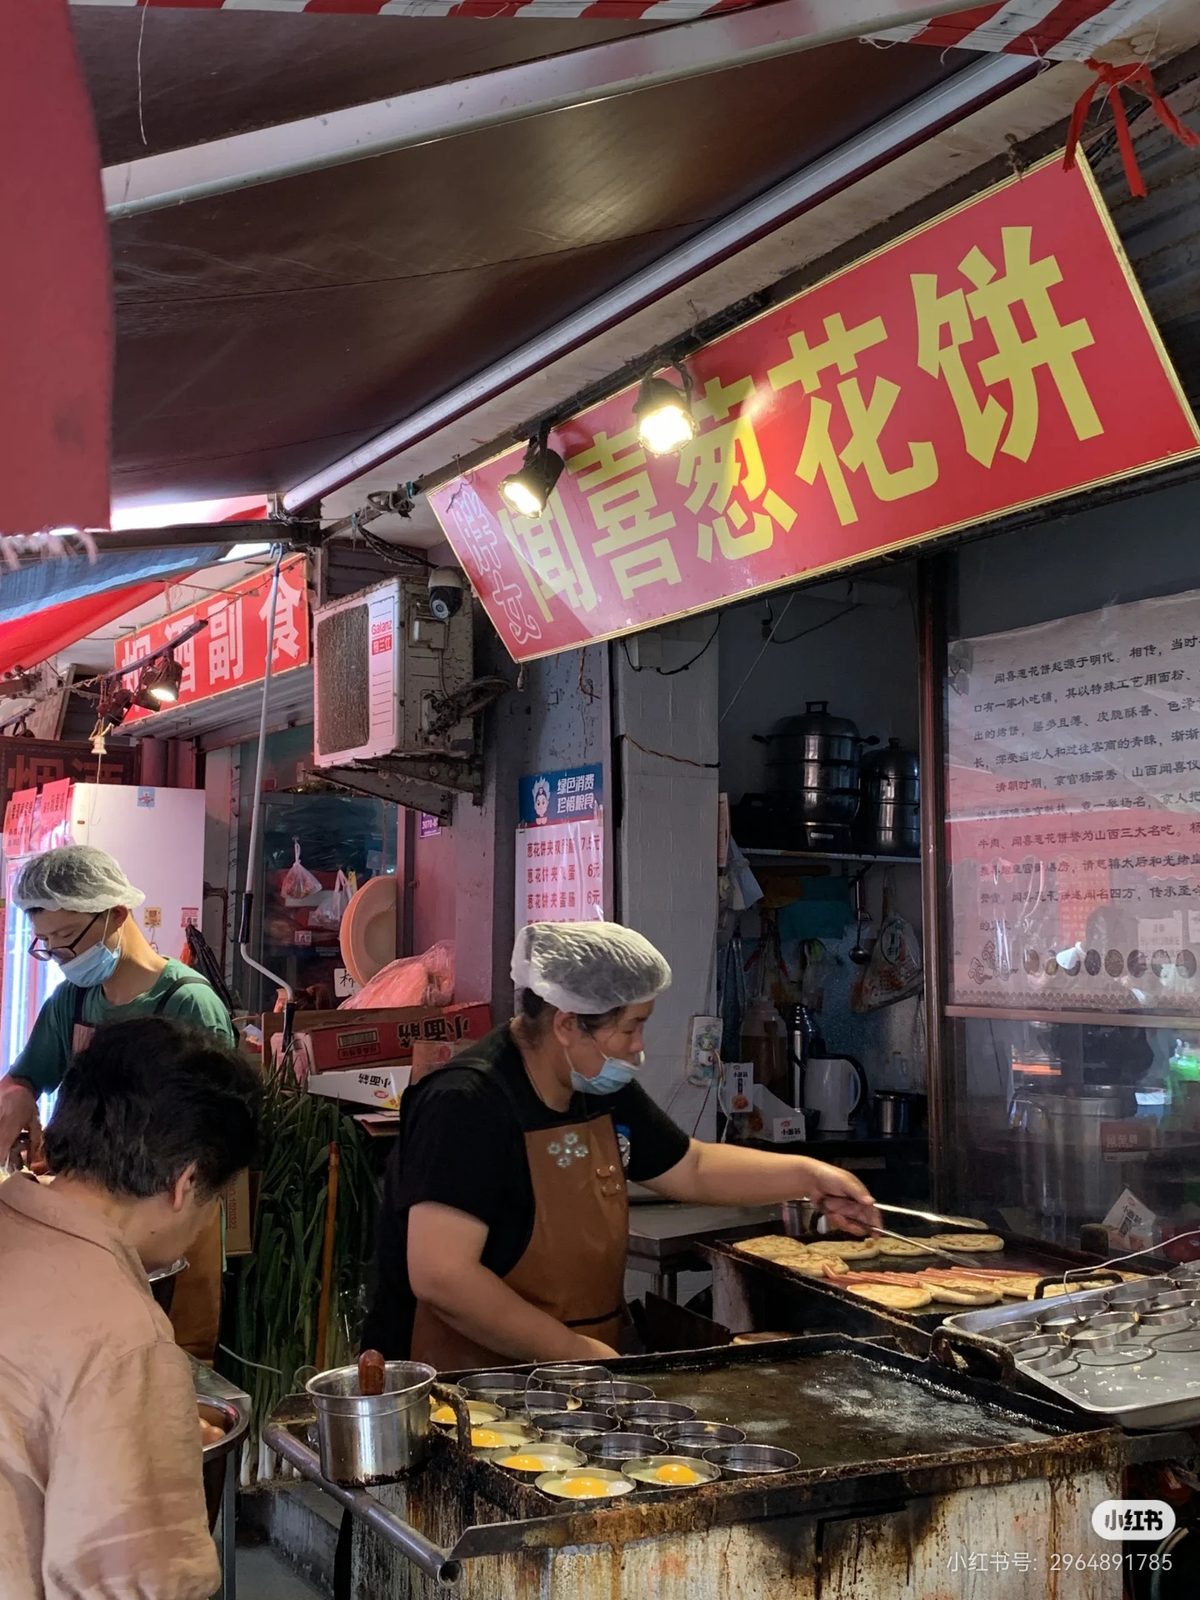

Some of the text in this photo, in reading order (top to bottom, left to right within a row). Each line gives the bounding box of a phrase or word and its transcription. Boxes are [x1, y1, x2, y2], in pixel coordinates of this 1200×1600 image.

[497, 226, 1105, 623] 闻喜葱花饼
[371, 620, 392, 635] Galanz
[994, 634, 1200, 685] 闻喜葱花饼起源于明代。相传，当时
[974, 697, 1200, 741] 出的烤饼，层多且薄、皮脆酥香、色泽
[557, 774, 595, 794] 绿色消费
[557, 793, 594, 814] 珍惜粮食
[587, 862, 600, 878] 6元
[587, 889, 600, 906] 6元
[397, 1014, 470, 1049] 小面筋
[358, 1072, 392, 1088] 小面筋
